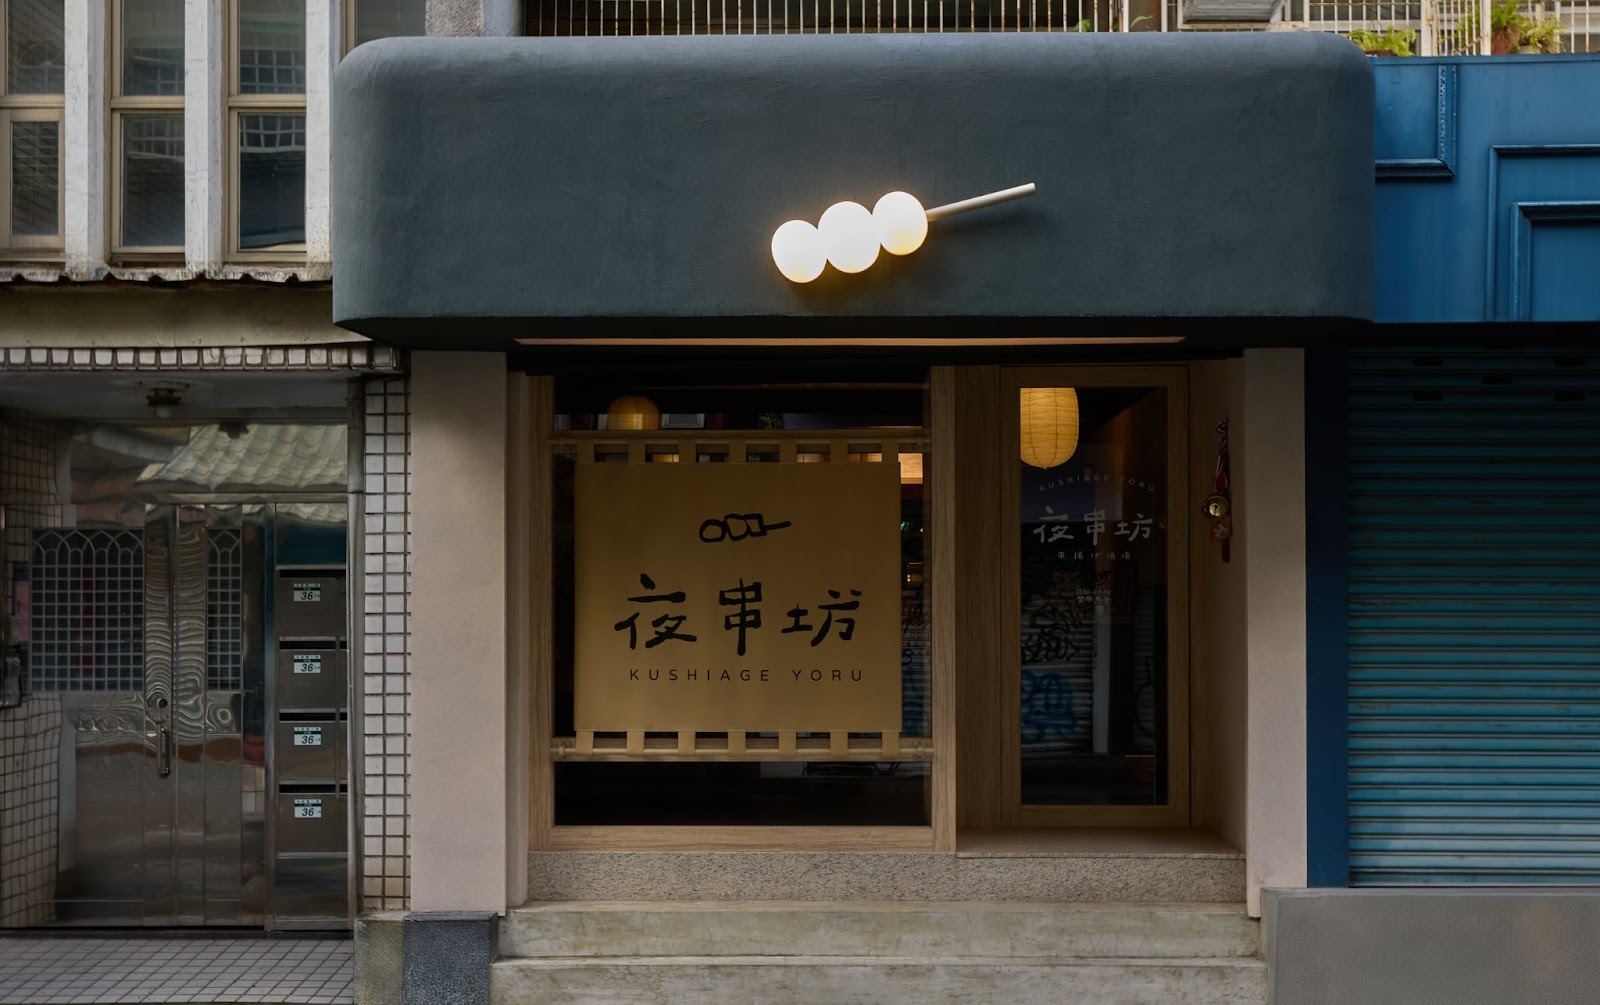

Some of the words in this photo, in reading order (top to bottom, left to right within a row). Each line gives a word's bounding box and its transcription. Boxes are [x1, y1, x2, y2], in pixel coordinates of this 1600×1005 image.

[1039, 474, 1110, 492] KUSHIAGE
[1120, 475, 1155, 492] YORU
[1033, 505, 1153, 546] 夜串坊
[301, 591, 314, 600] 36
[614, 573, 863, 656] 夜串坊
[301, 663, 314, 672] 36
[630, 669, 770, 682] KUSHIAGE
[792, 669, 863, 682] YORU
[301, 735, 315, 744] 36
[302, 807, 315, 816] 36
